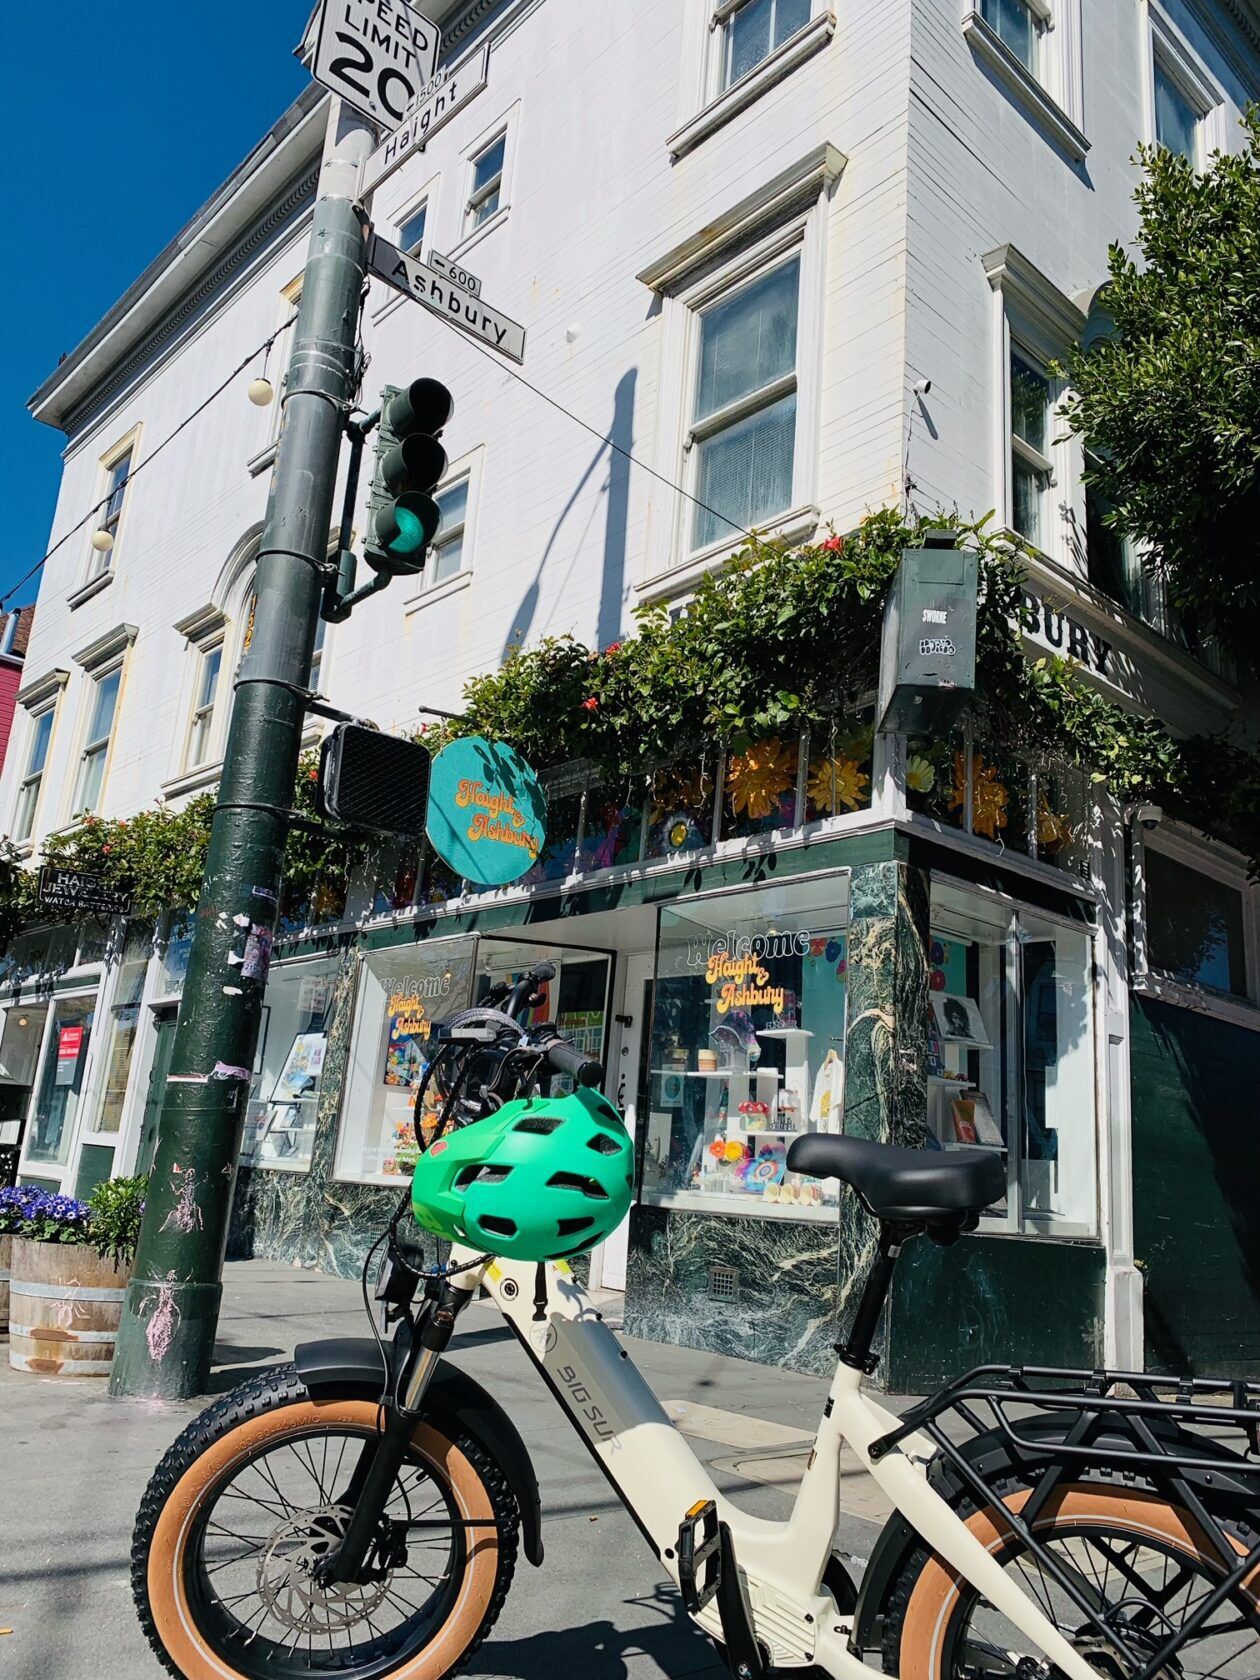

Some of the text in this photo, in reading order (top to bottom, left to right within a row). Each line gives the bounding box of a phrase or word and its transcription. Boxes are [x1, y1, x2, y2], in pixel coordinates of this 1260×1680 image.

[344, 4, 417, 69] LIMIT
[357, 0, 429, 52] EED
[328, 31, 416, 122] 20
[415, 72, 443, 107] 1500
[384, 81, 458, 165] Haight
[448, 266, 476, 291] 600
[391, 259, 508, 345] Ashbury
[455, 778, 516, 819] Haight
[467, 813, 541, 859] Ashbury
[686, 929, 812, 967] Welcome
[380, 975, 451, 999] Welcome
[705, 951, 760, 985] Haight
[387, 992, 420, 1018] Haight
[716, 982, 785, 1014] Ashbury
[391, 1017, 432, 1040] Ashbury
[556, 1365, 593, 1404] BIG
[582, 1405, 623, 1455] SUR
